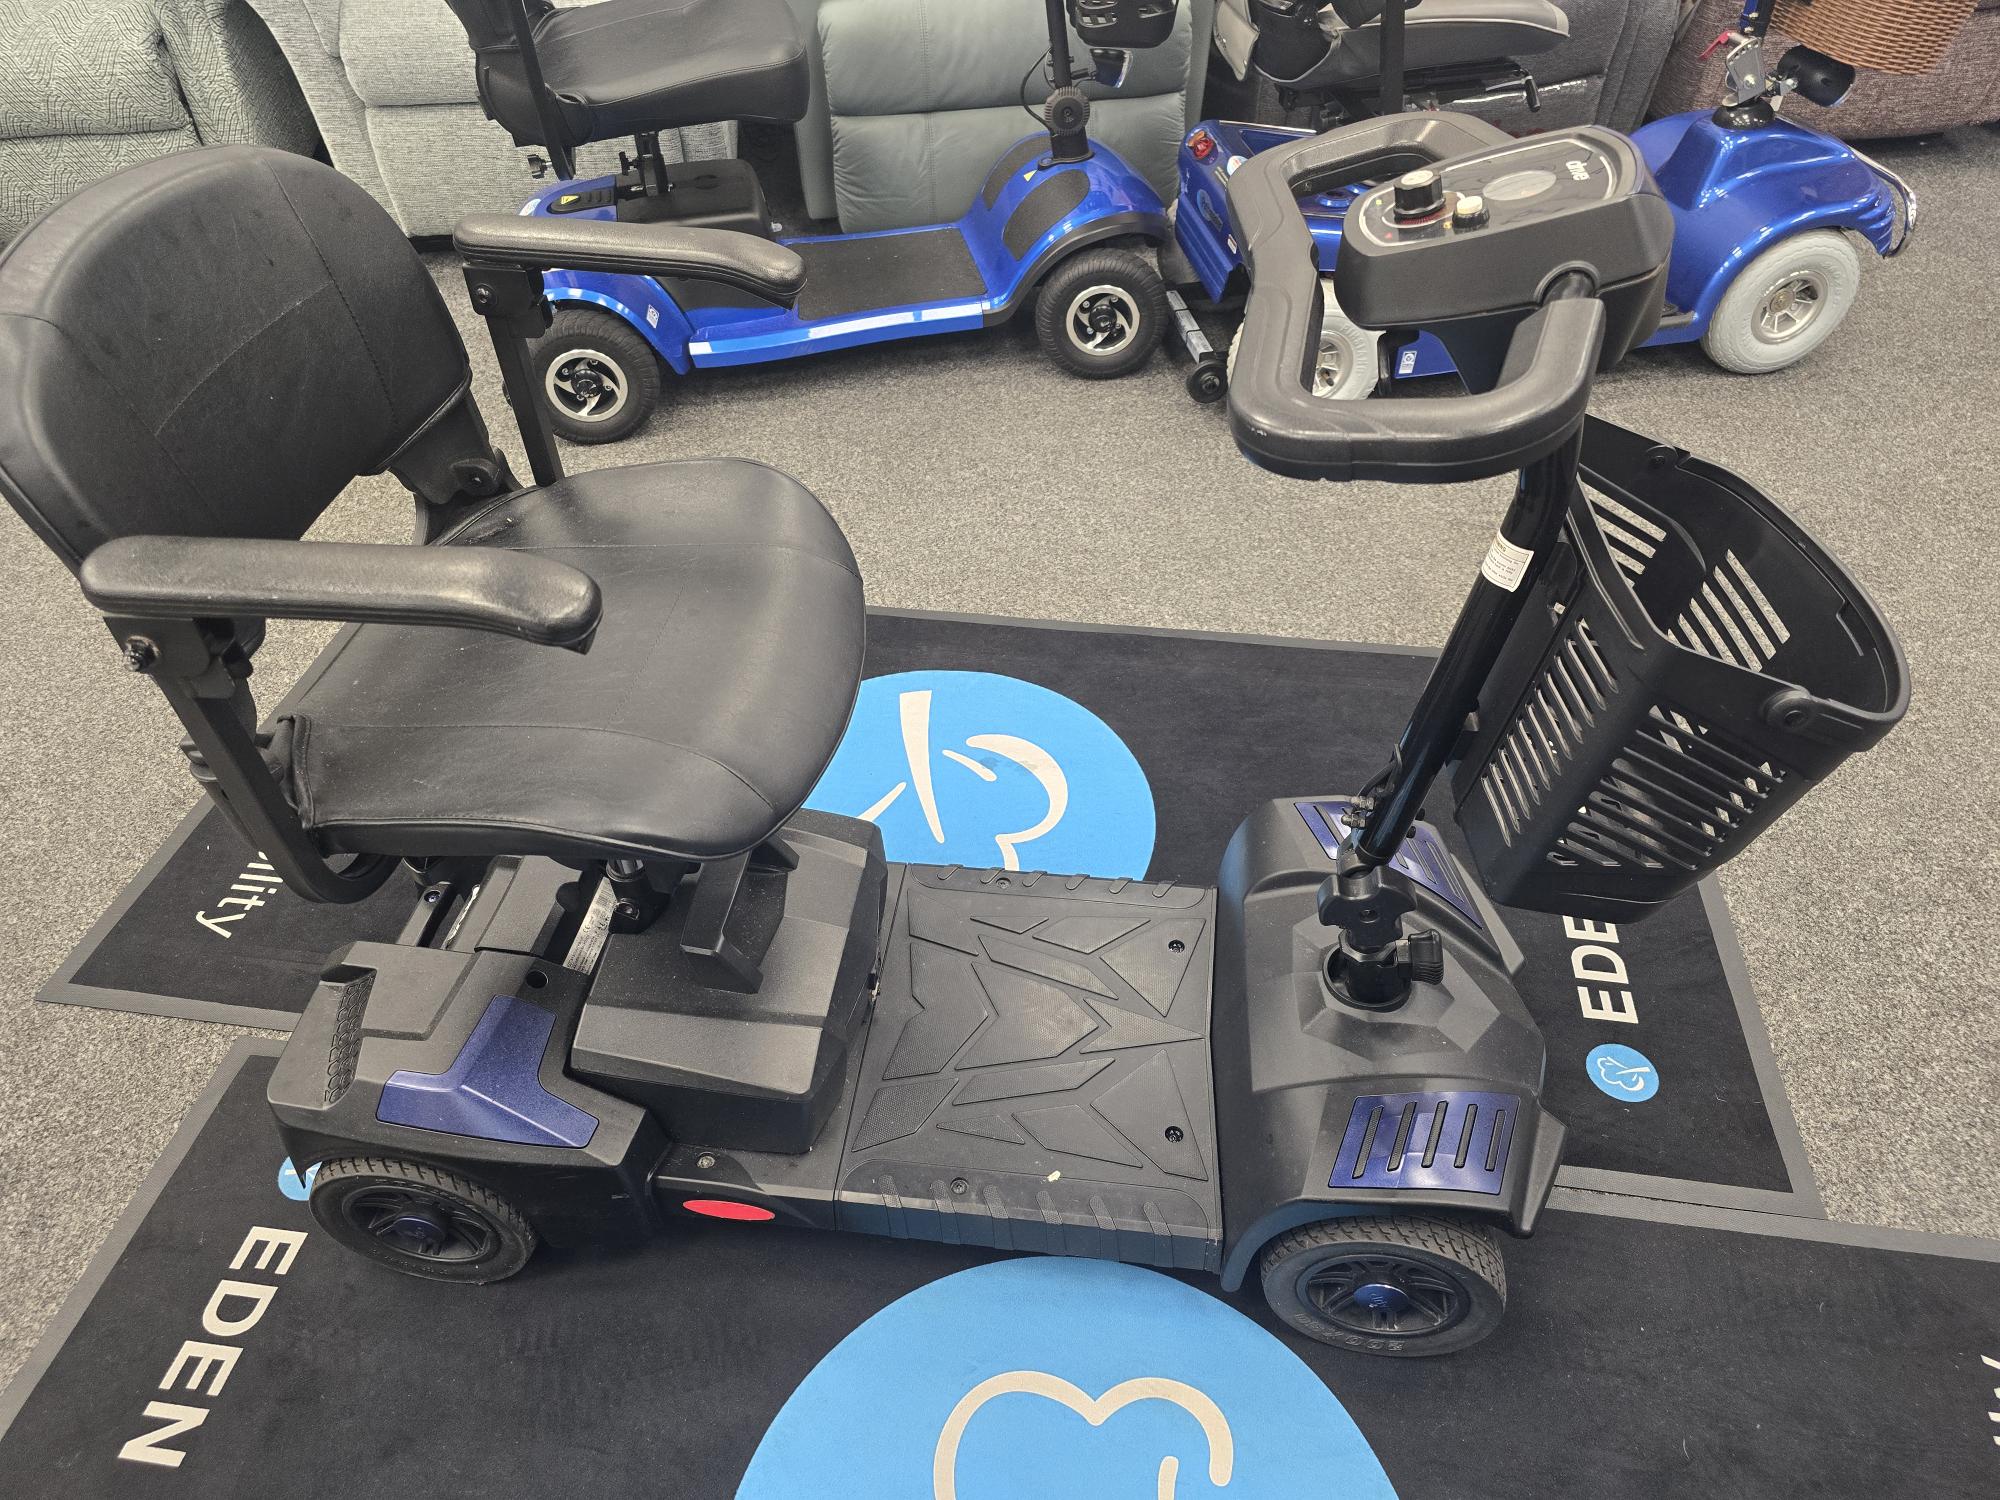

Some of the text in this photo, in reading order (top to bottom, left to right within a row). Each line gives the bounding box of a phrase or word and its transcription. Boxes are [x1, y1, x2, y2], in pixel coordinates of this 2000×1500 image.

[195, 850, 284, 939] ility
[1562, 914, 1639, 1025] EDE
[117, 1225, 309, 1468] EDEN
